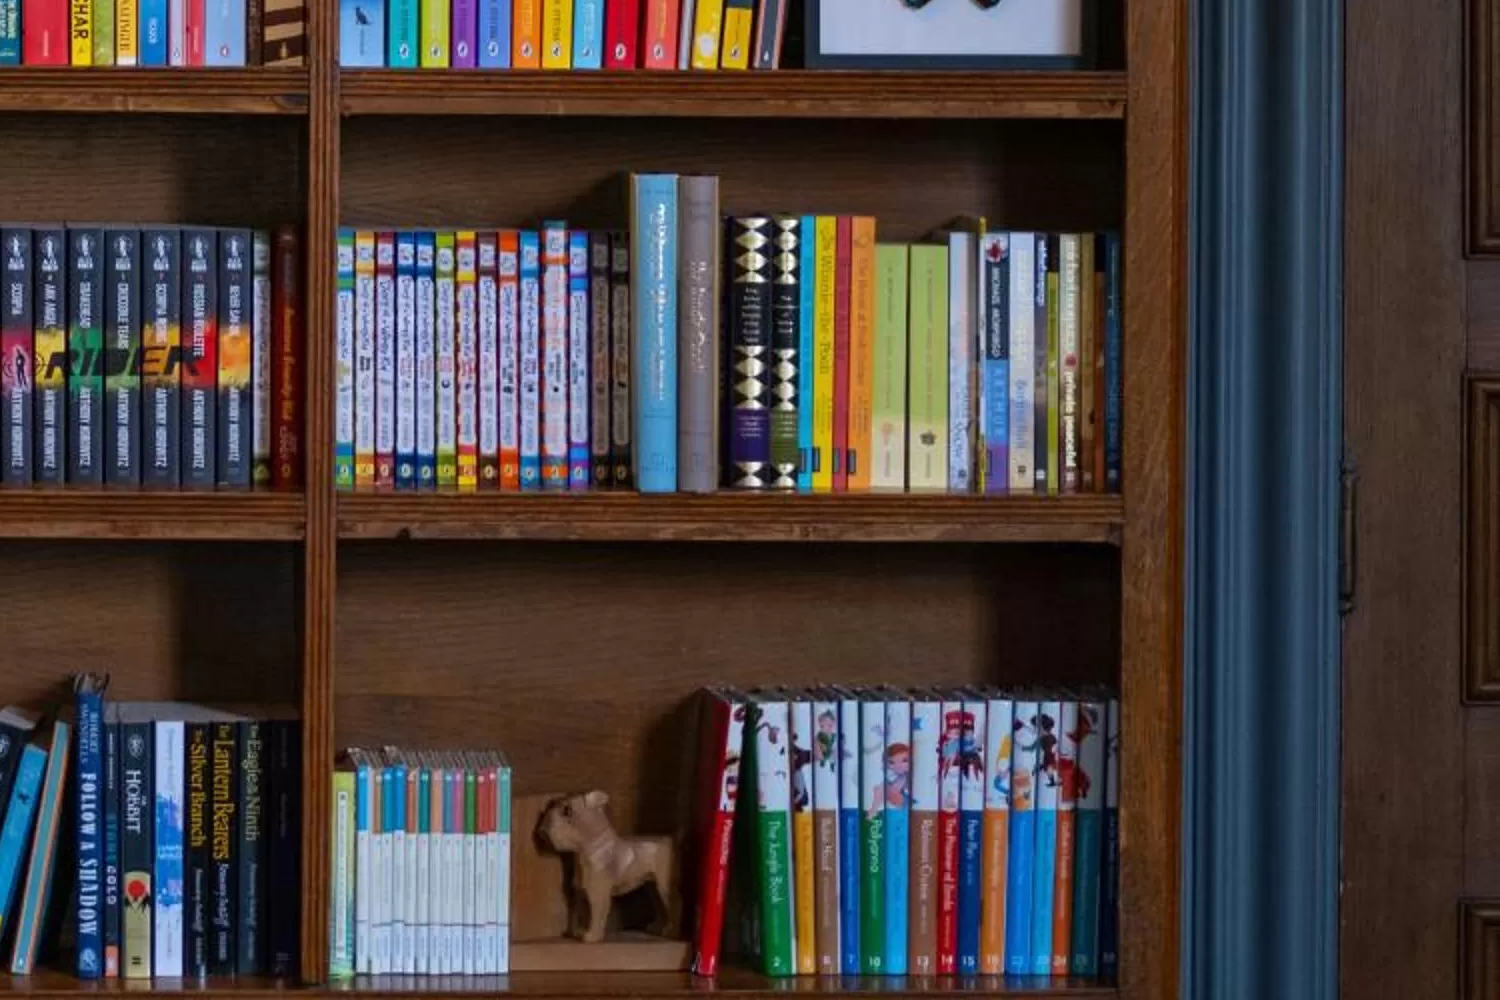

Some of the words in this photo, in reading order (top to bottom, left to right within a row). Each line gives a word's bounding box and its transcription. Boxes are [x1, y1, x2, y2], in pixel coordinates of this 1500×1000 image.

[117, 387, 129, 422] ANTHONY
[156, 387, 168, 422] ANTHONY
[193, 389, 205, 424] ANTHONY
[1064, 371, 1075, 413] private
[1064, 415, 1076, 467] peaceful
[191, 743, 206, 789] Silver
[212, 739, 235, 801] Lantern
[243, 739, 262, 778] Eagle
[80, 772, 97, 835] FOLLOW
[125, 769, 142, 834] HOBBIT
[190, 792, 205, 846] Branch
[245, 796, 260, 842] Ninth
[80, 842, 96, 850] A
[212, 803, 235, 859] Bearers
[767, 820, 781, 839] The
[867, 818, 882, 873] Pollyanna
[763, 842, 781, 874] Jungle
[78, 858, 99, 936] SHADOW
[106, 865, 116, 905] COLD
[769, 876, 784, 904] Book
